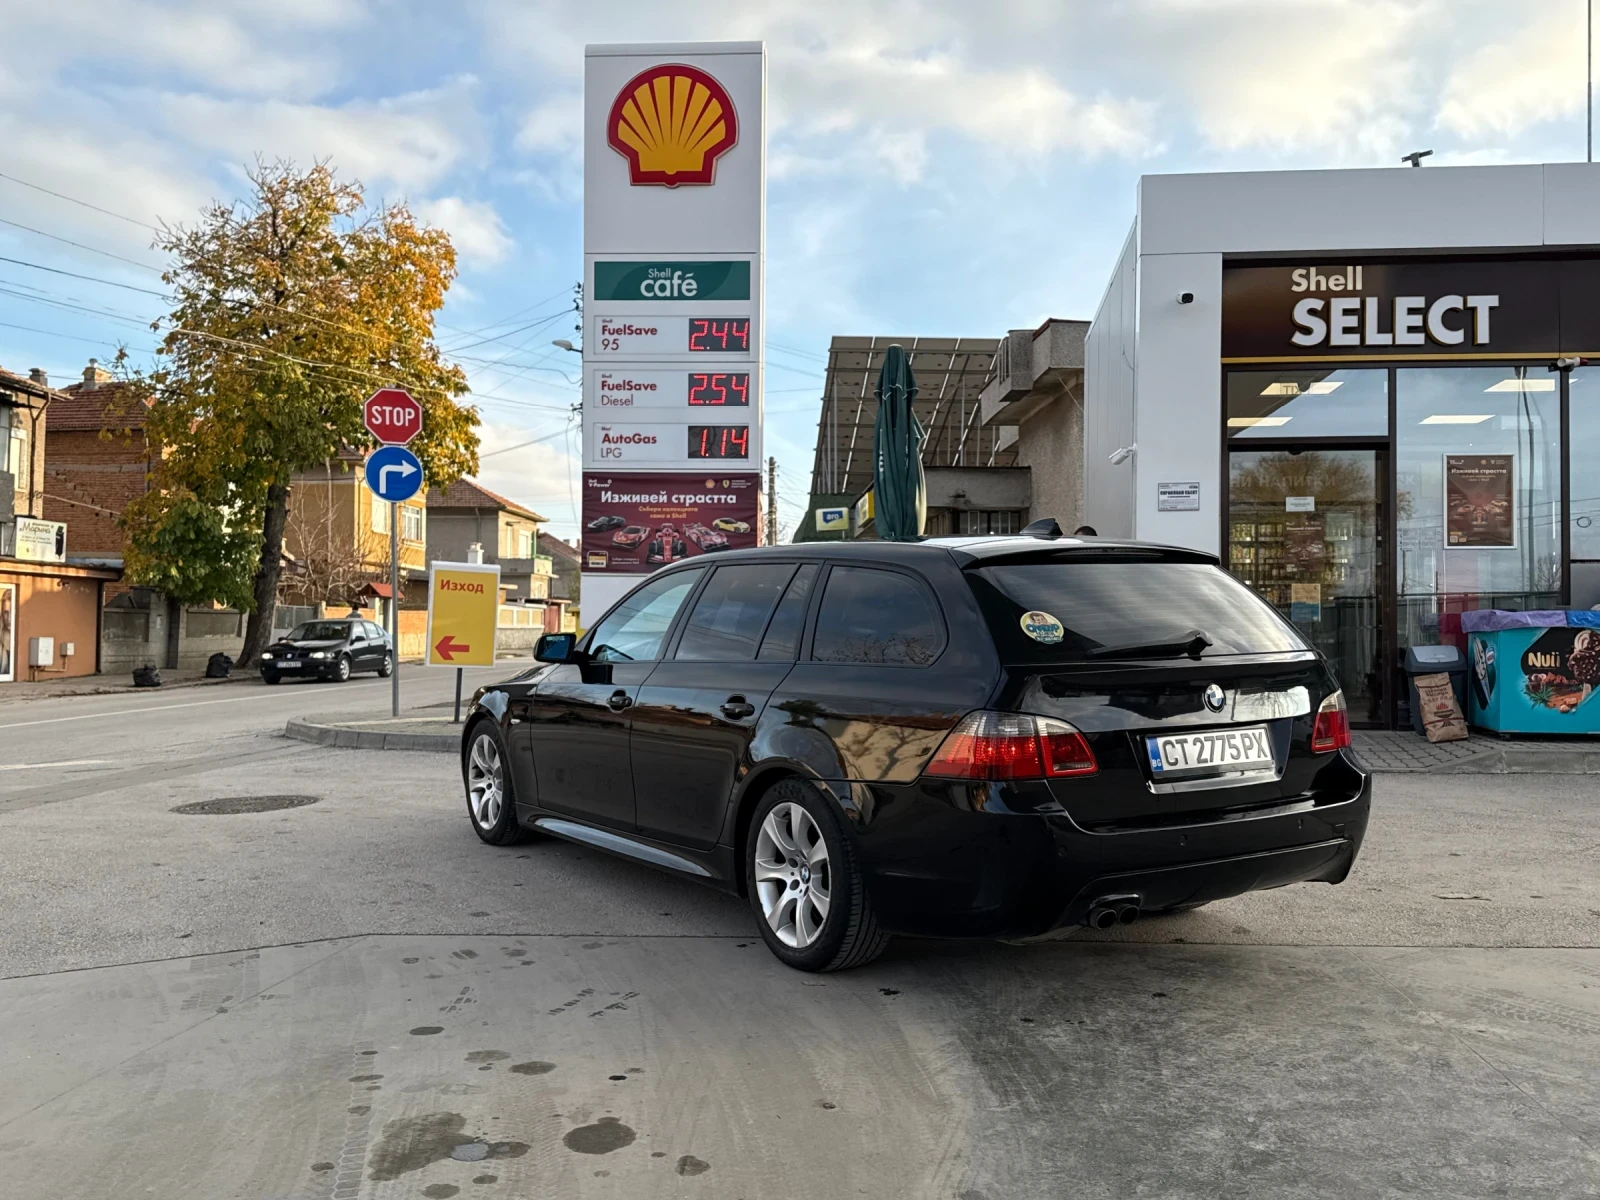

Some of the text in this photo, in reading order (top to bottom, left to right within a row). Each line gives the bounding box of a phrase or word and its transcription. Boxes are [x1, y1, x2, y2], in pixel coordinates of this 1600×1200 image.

[648, 268, 671, 278] Shell
[1291, 265, 1363, 293] Shell
[640, 271, 698, 297] café
[1290, 294, 1499, 347] SELECT
[601, 324, 658, 336] FuelSave
[690, 320, 749, 350] 2.44
[601, 338, 620, 351] 95
[601, 379, 657, 391] FuelSave
[689, 375, 749, 404] 2.54
[601, 393, 634, 406] Diesel
[371, 405, 415, 427] STOP
[601, 433, 657, 444] AutoGas
[700, 428, 748, 457] 1.14
[600, 447, 622, 458] LPG
[601, 490, 737, 506] Изживей страстта
[440, 578, 484, 594] Изход
[1527, 651, 1561, 668] Nuii
[1192, 734, 1242, 764] 2775
